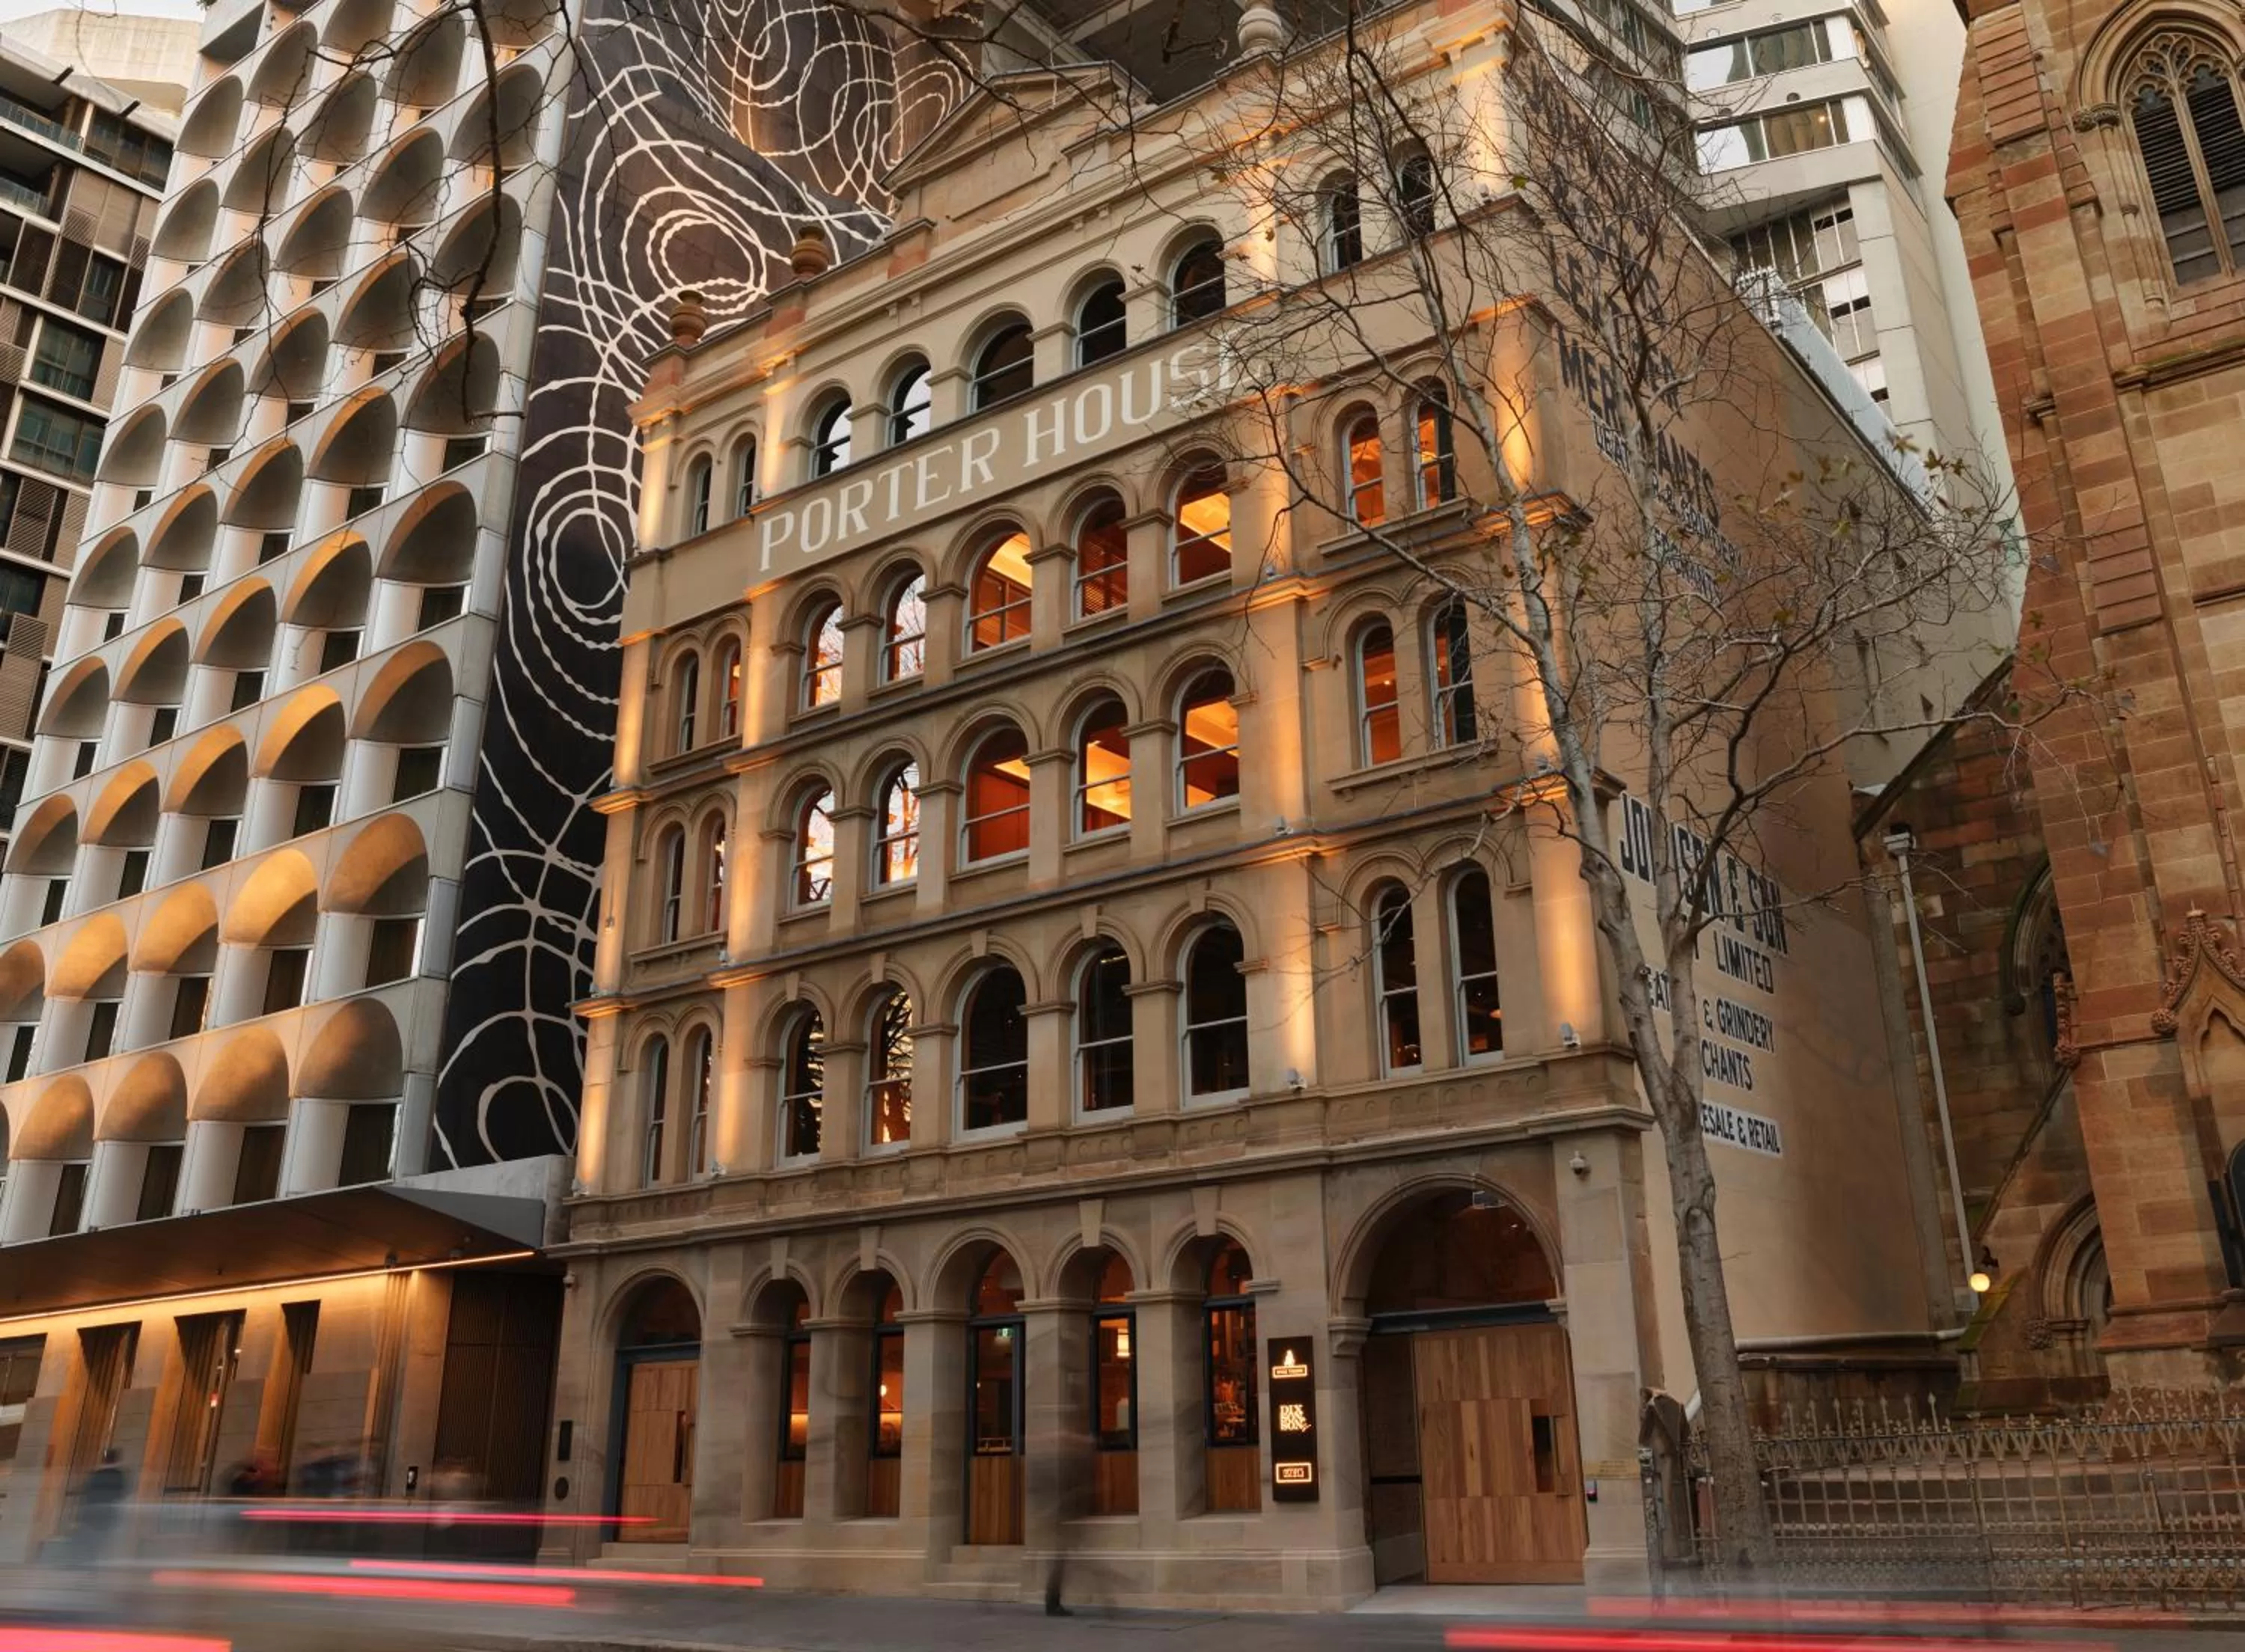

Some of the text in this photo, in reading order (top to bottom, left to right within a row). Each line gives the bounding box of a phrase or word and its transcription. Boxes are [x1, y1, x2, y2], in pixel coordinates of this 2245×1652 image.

[757, 323, 1260, 572] PORTER HOUSE
[1558, 326, 1719, 527] MERANTS
[1592, 414, 1661, 498] LEATR
[1654, 524, 1724, 608] ERCHANTS
[1747, 866, 1788, 955] SON
[1714, 930, 1774, 994] LIMITED
[1700, 1038, 1753, 1092] CHANTS
[1702, 997, 1775, 1053] & GRINDERY
[1699, 1104, 1780, 1154] ESALE & RETAIL
